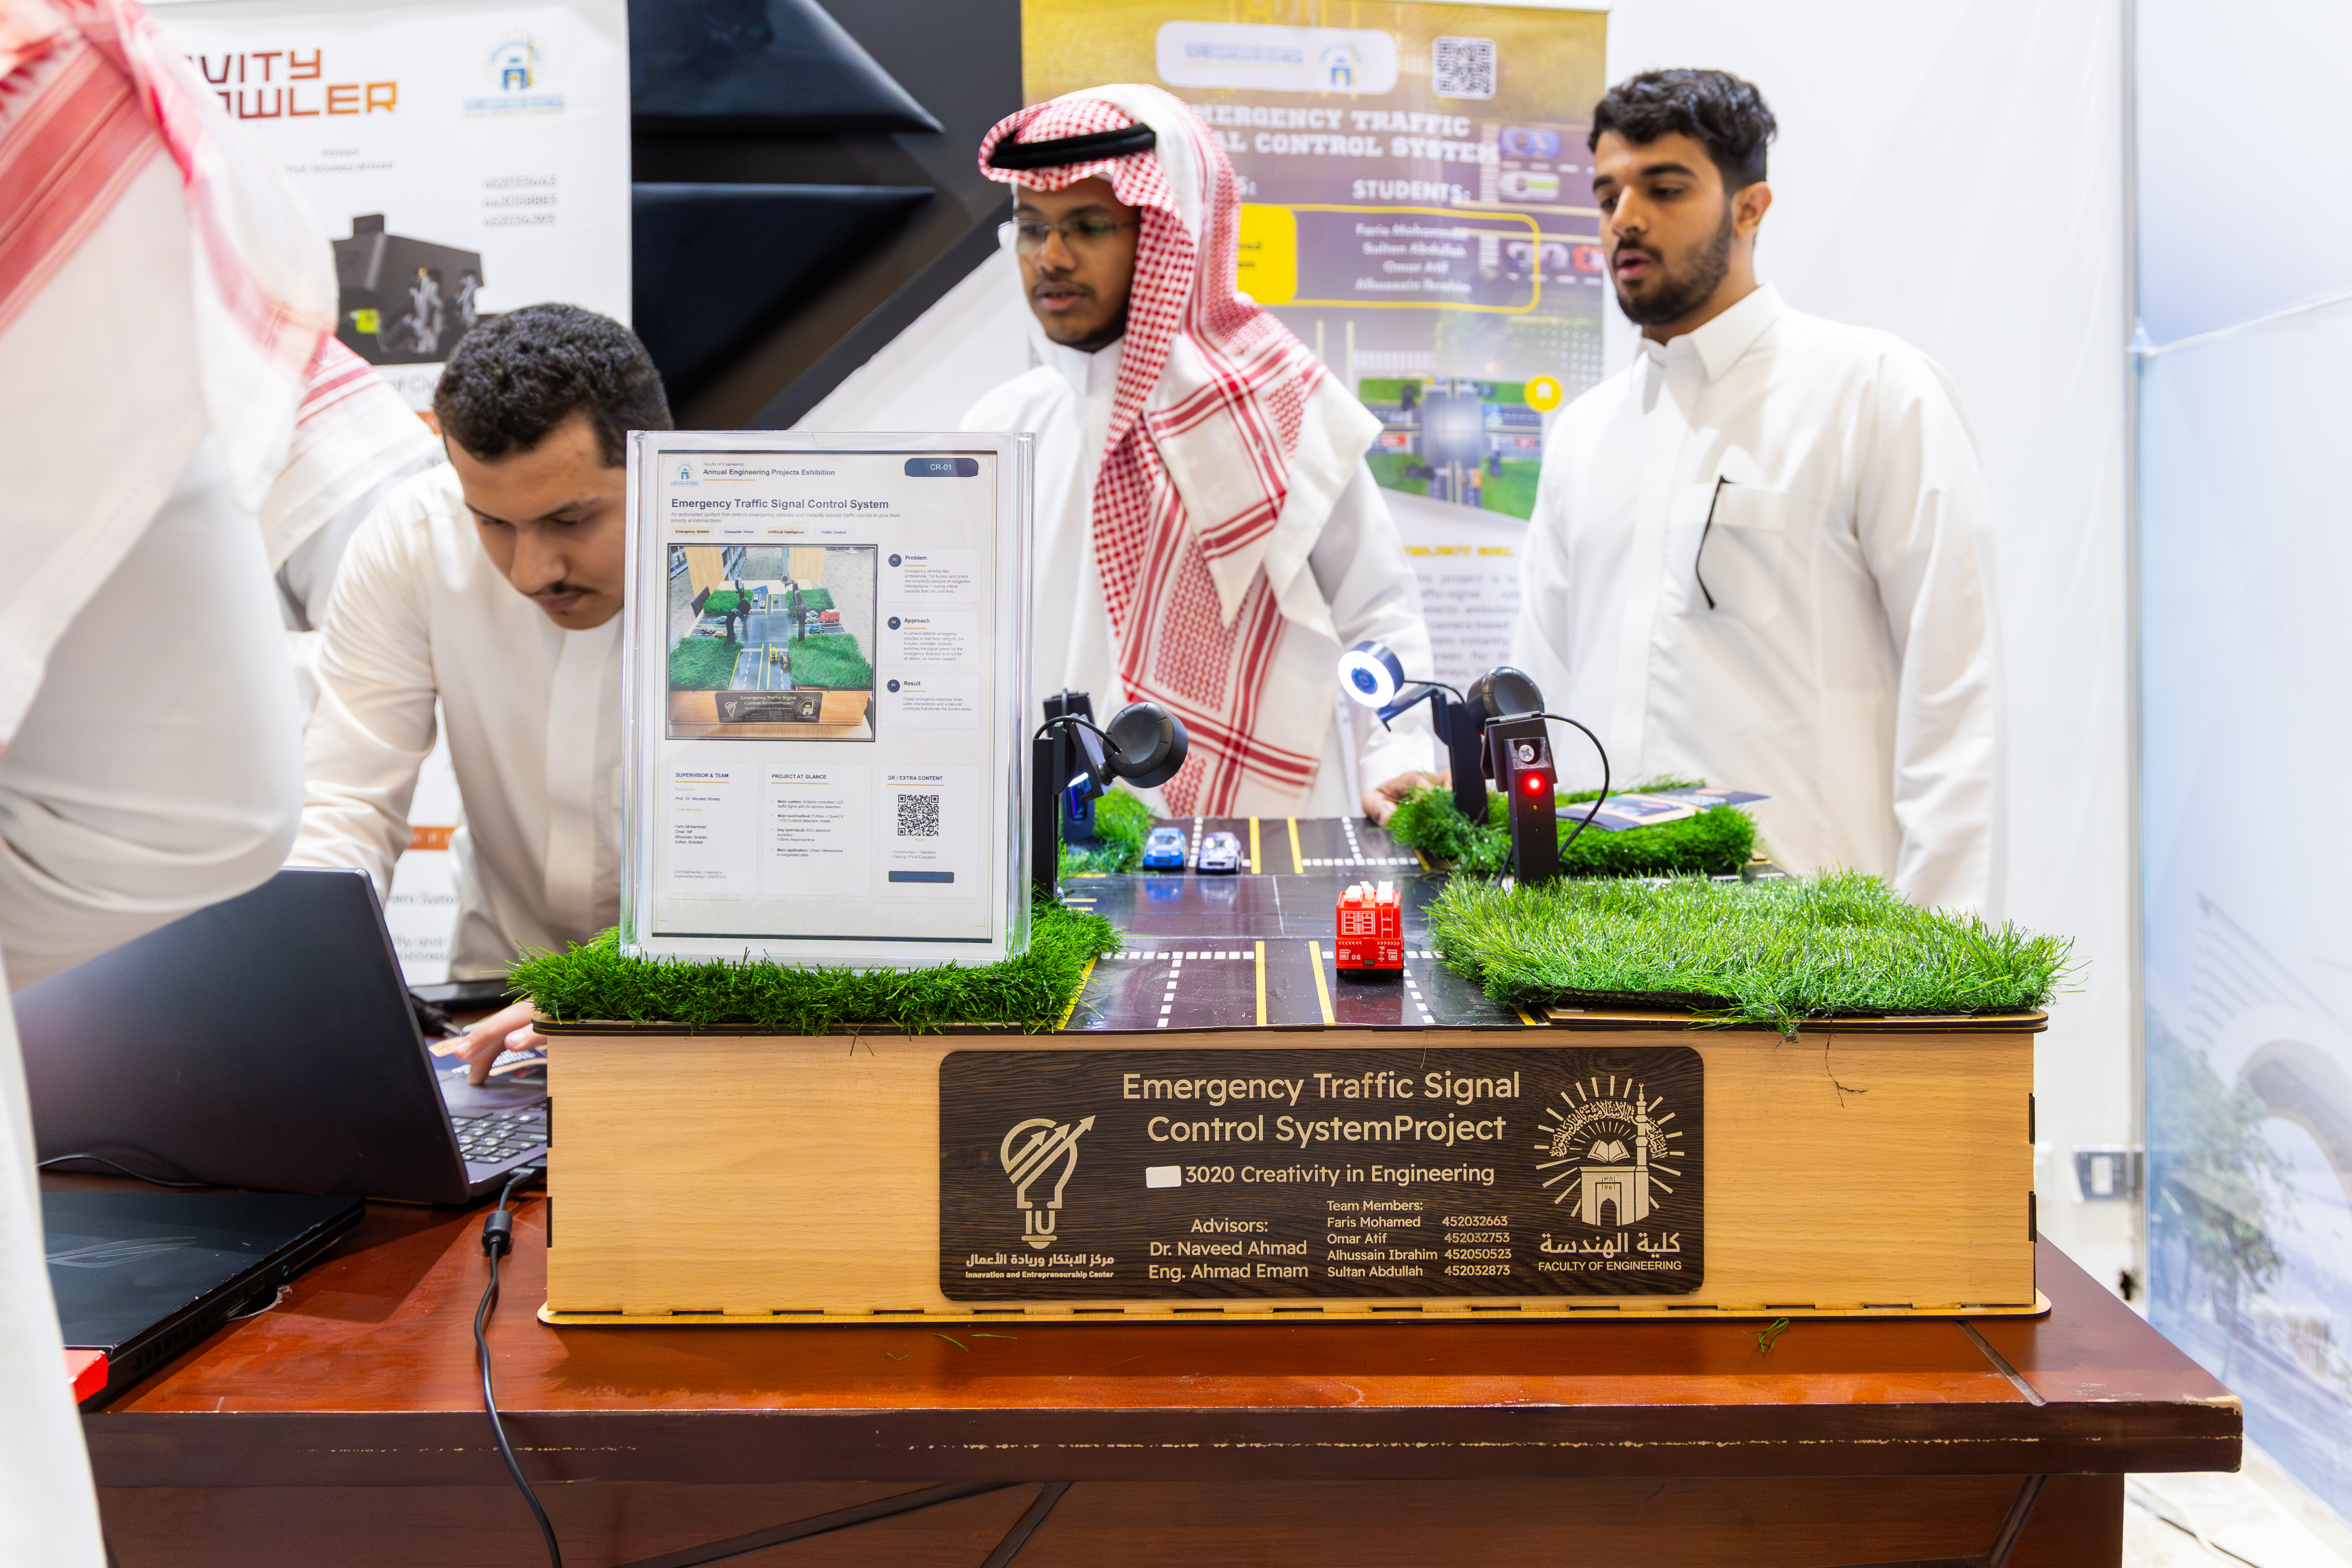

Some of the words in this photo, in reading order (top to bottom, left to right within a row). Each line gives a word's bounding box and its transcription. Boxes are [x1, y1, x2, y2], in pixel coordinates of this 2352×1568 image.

[186, 48, 321, 84] VITY
[216, 82, 397, 119] WLER
[1189, 104, 1345, 129] MERGENCY
[1351, 110, 1471, 137] TRAFFIC
[1254, 132, 1384, 158] CONTROL
[1390, 136, 1500, 165] SYSTEM
[1352, 179, 1471, 203] STUDENTS:
[672, 499, 731, 509] Emergency
[734, 499, 767, 508] Traffic
[771, 499, 804, 510] Signal
[808, 499, 847, 508] Control
[850, 500, 888, 510] System
[1124, 1074, 1304, 1106] Emergency
[1314, 1071, 1414, 1098] Traffic
[1424, 1071, 1519, 1105] Signal
[1148, 1115, 1263, 1142] Control
[1275, 1113, 1506, 1148] SystemProject
[1185, 1166, 1234, 1182] 3020
[1241, 1164, 1340, 1187] Creativity
[1347, 1164, 1363, 1182] in
[1372, 1163, 1494, 1187] Engineering
[1327, 1200, 1359, 1211] Team
[1363, 1200, 1423, 1211] Members:
[1026, 1210, 1055, 1234] IU
[1191, 1217, 1268, 1233] Advisors:
[1327, 1216, 1356, 1227] Faris
[1360, 1216, 1421, 1227] Mohamed
[1442, 1216, 1508, 1227] 452032663
[1327, 1234, 1361, 1244] Omar
[1364, 1233, 1387, 1243] Atif
[1444, 1232, 1510, 1243] 452032753
[1150, 1242, 1172, 1256] Dr.
[1178, 1240, 1242, 1256] Naveed
[1247, 1240, 1307, 1255] Ahmad
[1540, 1232, 1628, 1259] الهندسة
[1636, 1232, 1680, 1259] كلية
[966, 1253, 1007, 1267] الأعمال
[1011, 1254, 1045, 1267] وريادة
[1048, 1254, 1086, 1267] الابتكار
[1089, 1254, 1114, 1267] مركز
[1327, 1249, 1385, 1261] Alhussain
[1389, 1249, 1437, 1260] Ibrahim
[1444, 1249, 1511, 1259] 452050523
[1149, 1264, 1185, 1282] Eng.
[1191, 1263, 1250, 1278] Ahmad
[1257, 1264, 1308, 1277] Emam
[1328, 1266, 1365, 1277] Sultan
[1369, 1265, 1423, 1277] Abdullah
[1444, 1265, 1510, 1276] 452032873
[1538, 1262, 1586, 1271] FACULTY
[1588, 1262, 1604, 1271] OF
[1606, 1261, 1681, 1271] ENGINEERING
[1022, 1271, 1087, 1279] Entrepreneurship
